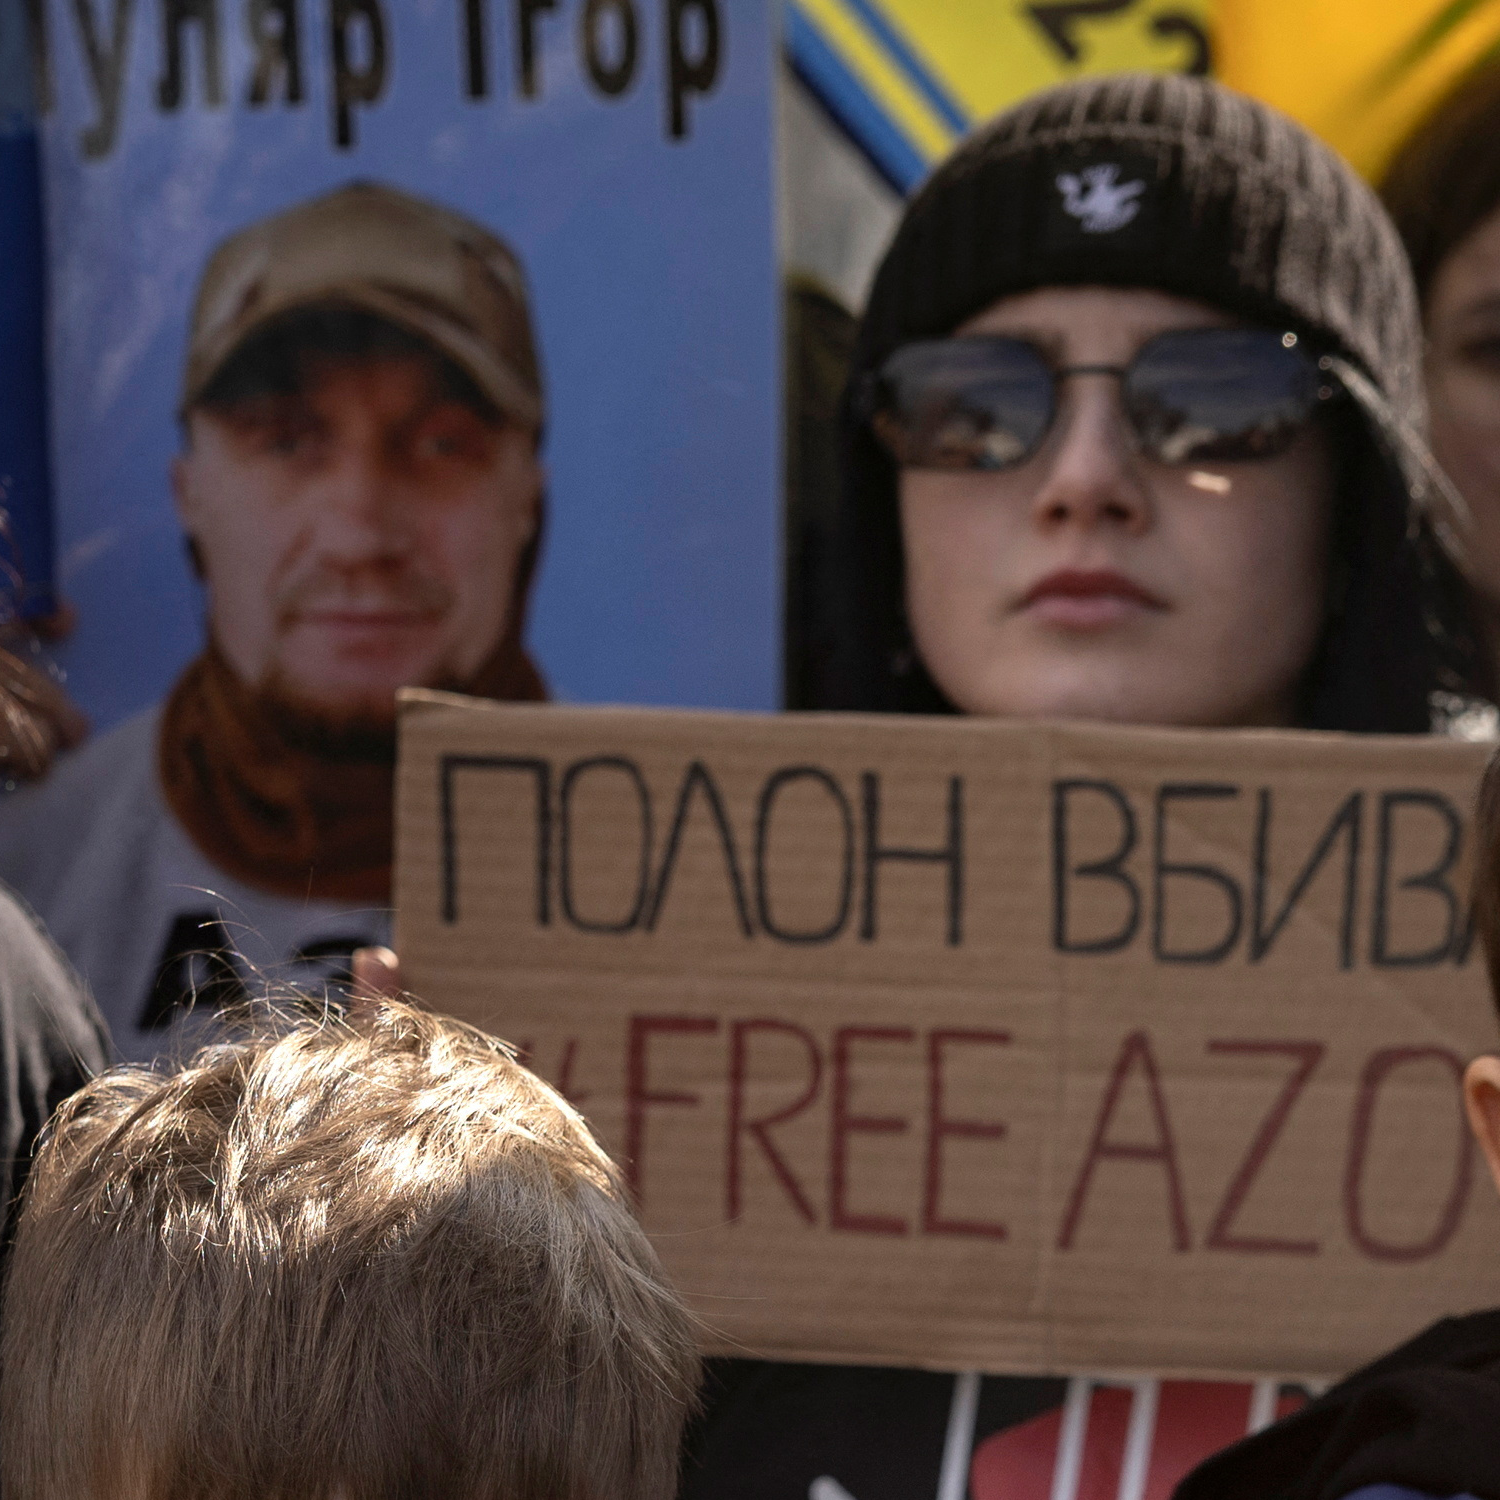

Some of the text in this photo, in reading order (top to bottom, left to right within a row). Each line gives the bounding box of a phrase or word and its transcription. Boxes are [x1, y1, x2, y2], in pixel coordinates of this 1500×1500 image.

[28, 0, 724, 160] уляр Ігор
[440, 752, 1482, 970] ПОЛОН ВБИВ
